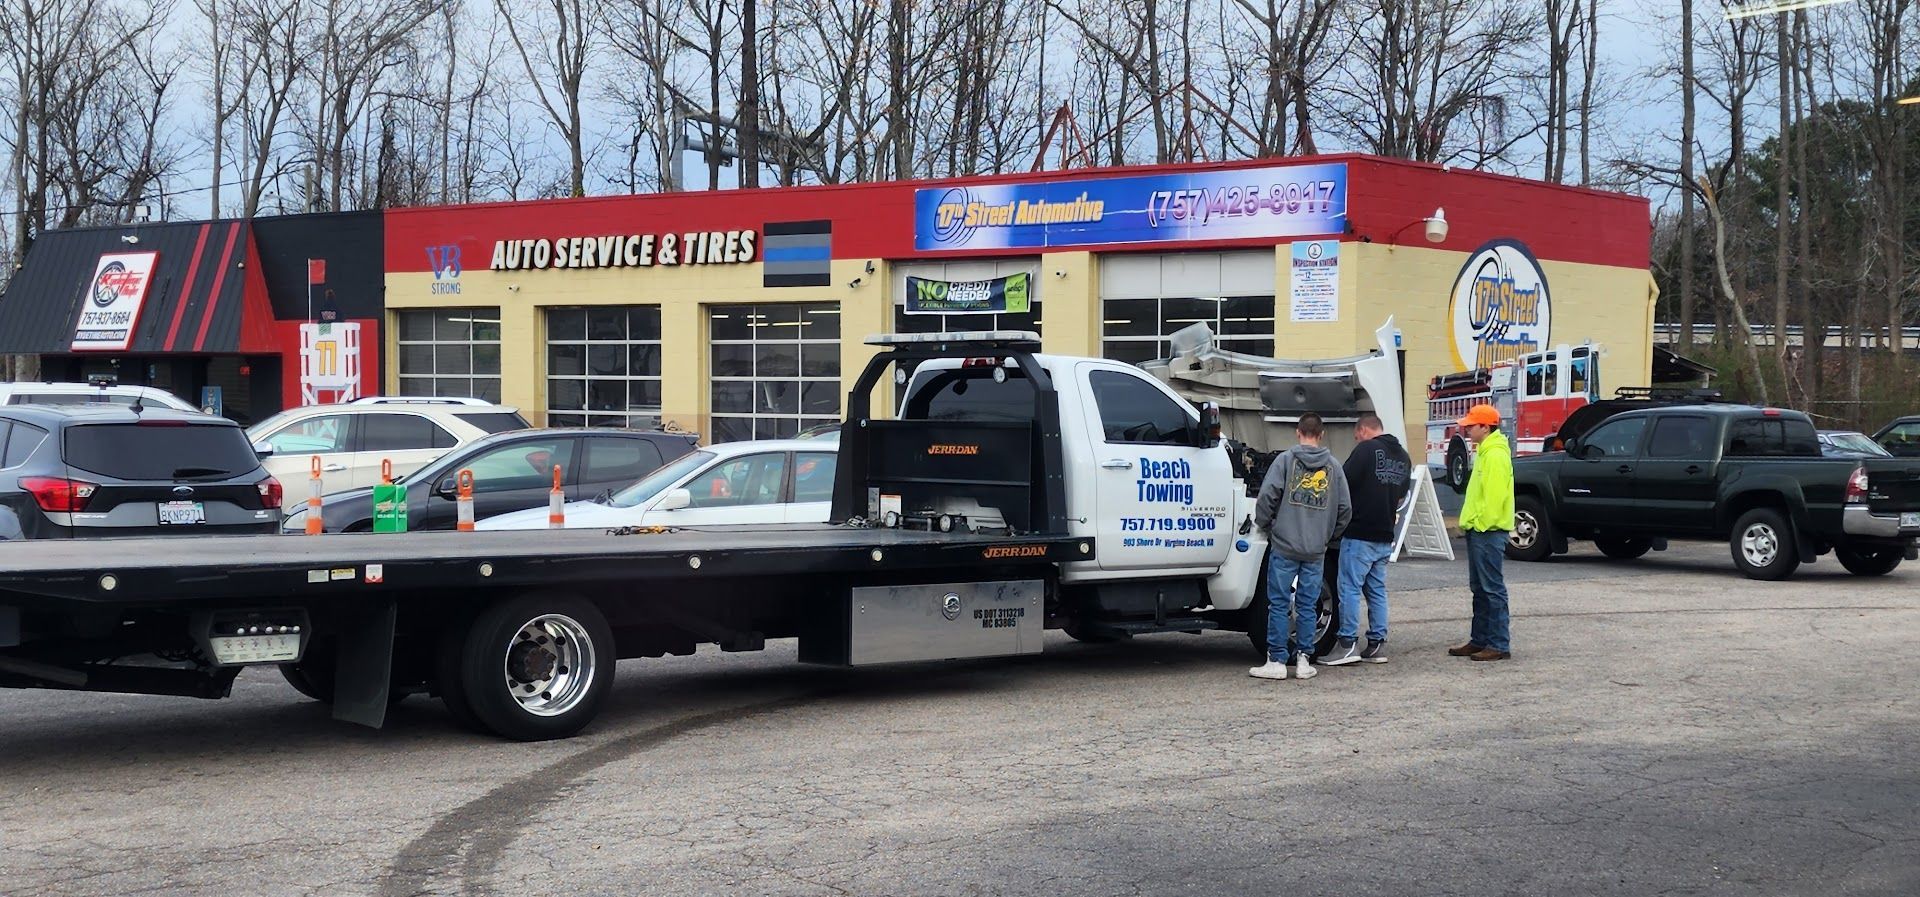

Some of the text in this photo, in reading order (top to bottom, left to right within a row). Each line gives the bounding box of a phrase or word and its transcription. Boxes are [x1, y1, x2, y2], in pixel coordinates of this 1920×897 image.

[938, 192, 1104, 229] 17th Street Automotive
[1148, 181, 1336, 228] (757)425-8917
[490, 229, 756, 270] AUTO SERVICE & TIRES
[431, 282, 461, 295] STRONG
[917, 280, 948, 301] NO
[949, 280, 993, 291] CREDIT
[946, 290, 991, 301] NEEDED
[1475, 277, 1540, 325] 17th Street
[81, 311, 131, 326] 757-937-8664
[1140, 458, 1191, 479] Beach
[1137, 480, 1194, 506] Towing
[1292, 491, 1328, 506] CREW
[161, 509, 201, 521] 8KNP971
[1120, 518, 1216, 531] 757.719.9900
[1123, 538, 1135, 547] 903
[1136, 538, 1154, 547] Shore
[1155, 537, 1162, 546] Dr
[1206, 538, 1214, 546] VA
[973, 609, 983, 620] US
[984, 608, 997, 619] DOT
[982, 618, 993, 629] MC
